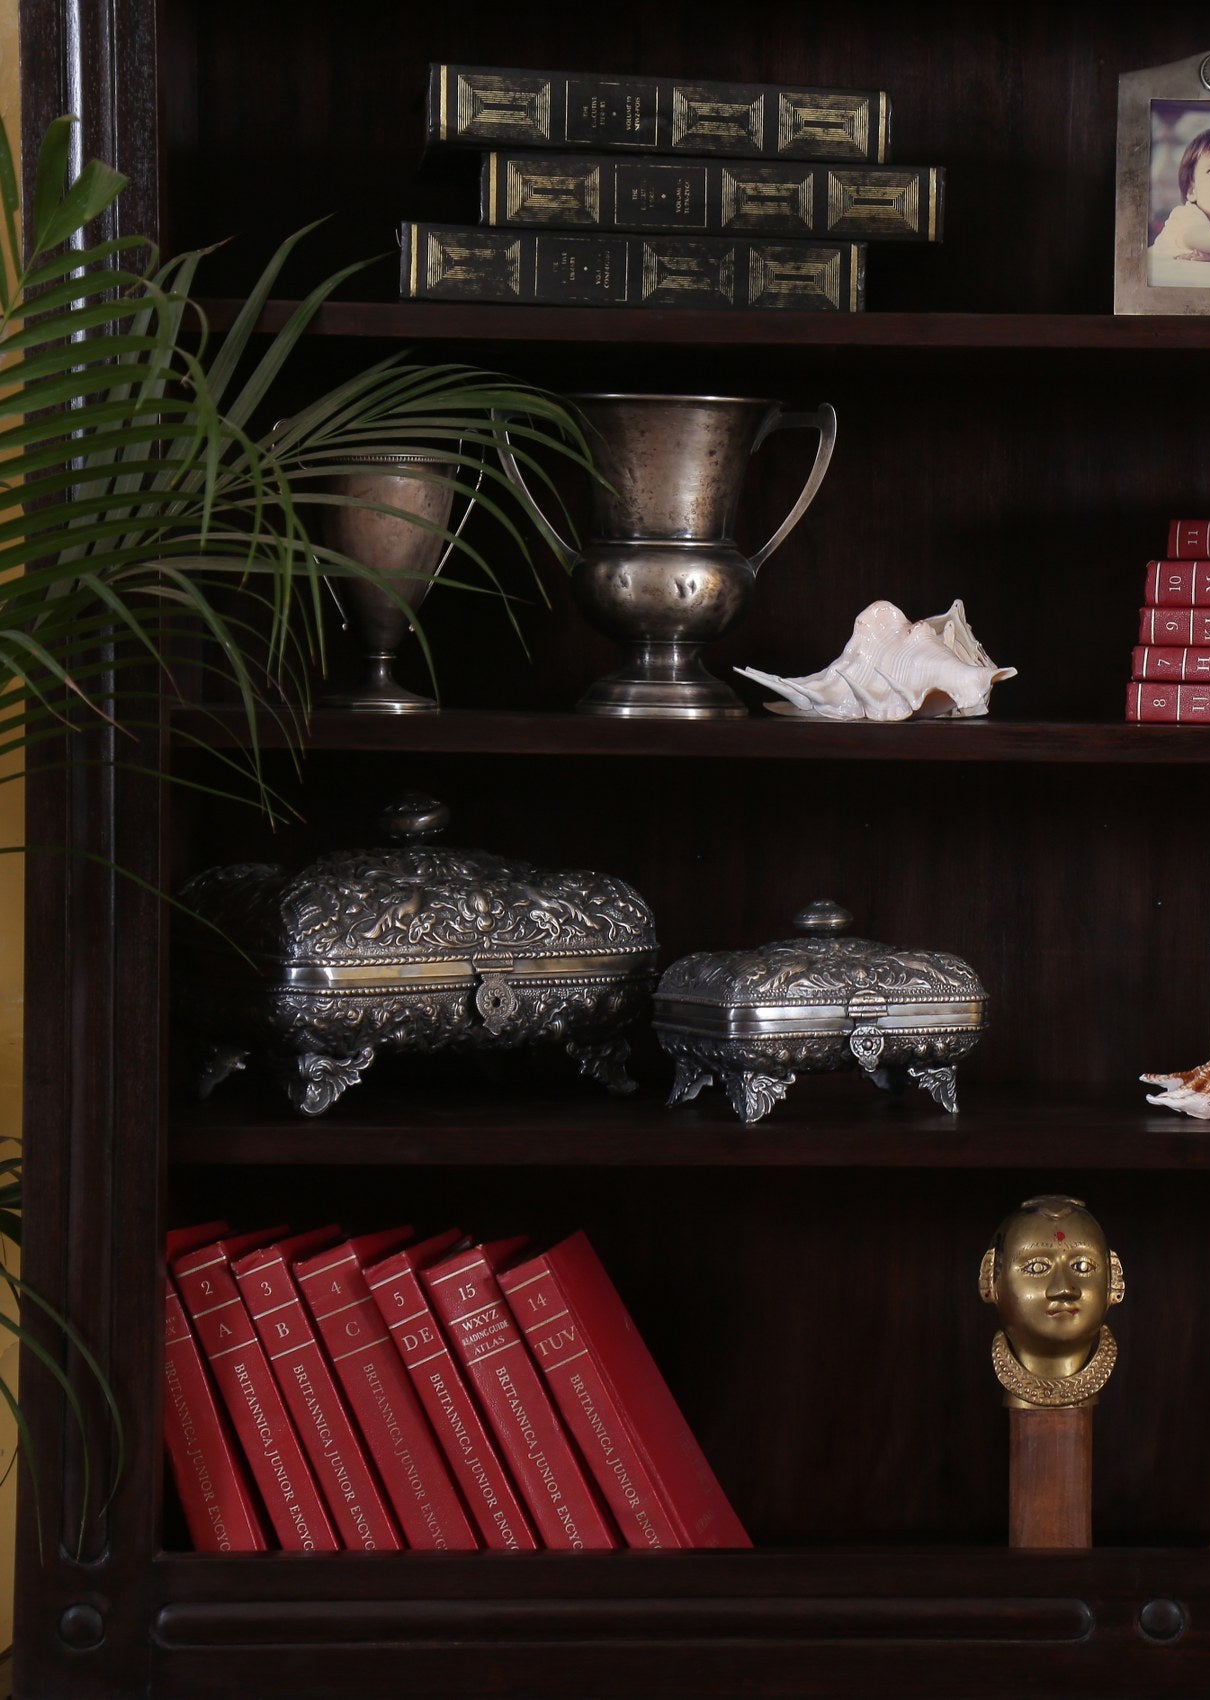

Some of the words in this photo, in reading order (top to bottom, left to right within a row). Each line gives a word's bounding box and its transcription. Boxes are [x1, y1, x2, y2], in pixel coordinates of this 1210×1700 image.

[1187, 529, 1199, 545] 11
[1168, 575, 1182, 592] 10
[1166, 621, 1179, 631] 9
[1157, 658, 1171, 667] 7
[1197, 656, 1210, 671] H
[1152, 698, 1166, 708] 8
[200, 1280, 213, 1295] 2
[260, 1281, 272, 1296] 3
[330, 1280, 341, 1294] 4
[458, 1282, 477, 1301] 15
[393, 1291, 404, 1307] 5
[527, 1292, 547, 1312] 14
[345, 1321, 360, 1337] C
[461, 1308, 499, 1332] WXYZ
[218, 1323, 232, 1338] A
[275, 1322, 290, 1338] B
[402, 1326, 434, 1352] DE
[461, 1328, 490, 1347] READING
[488, 1320, 509, 1334] GUIDE
[473, 1335, 505, 1356] ATLAS
[534, 1325, 576, 1357] TUV
[233, 1362, 273, 1448] BRITANNICA
[263, 1450, 295, 1502] JUNIOR
[292, 1364, 333, 1448] BRITANNICA
[324, 1450, 356, 1503] JUNIOR
[363, 1362, 404, 1446] BRITANNICA
[393, 1449, 426, 1500] JUNIOR
[429, 1372, 473, 1455] BRITANNICA
[464, 1457, 498, 1508] JUNIOR
[495, 1365, 538, 1450] BRITANNICA
[527, 1451, 562, 1503] JUNIOR
[570, 1373, 615, 1456] BRITANNICA
[606, 1458, 640, 1508] JUNIOR
[187, 1449, 215, 1502] JUNIOR
